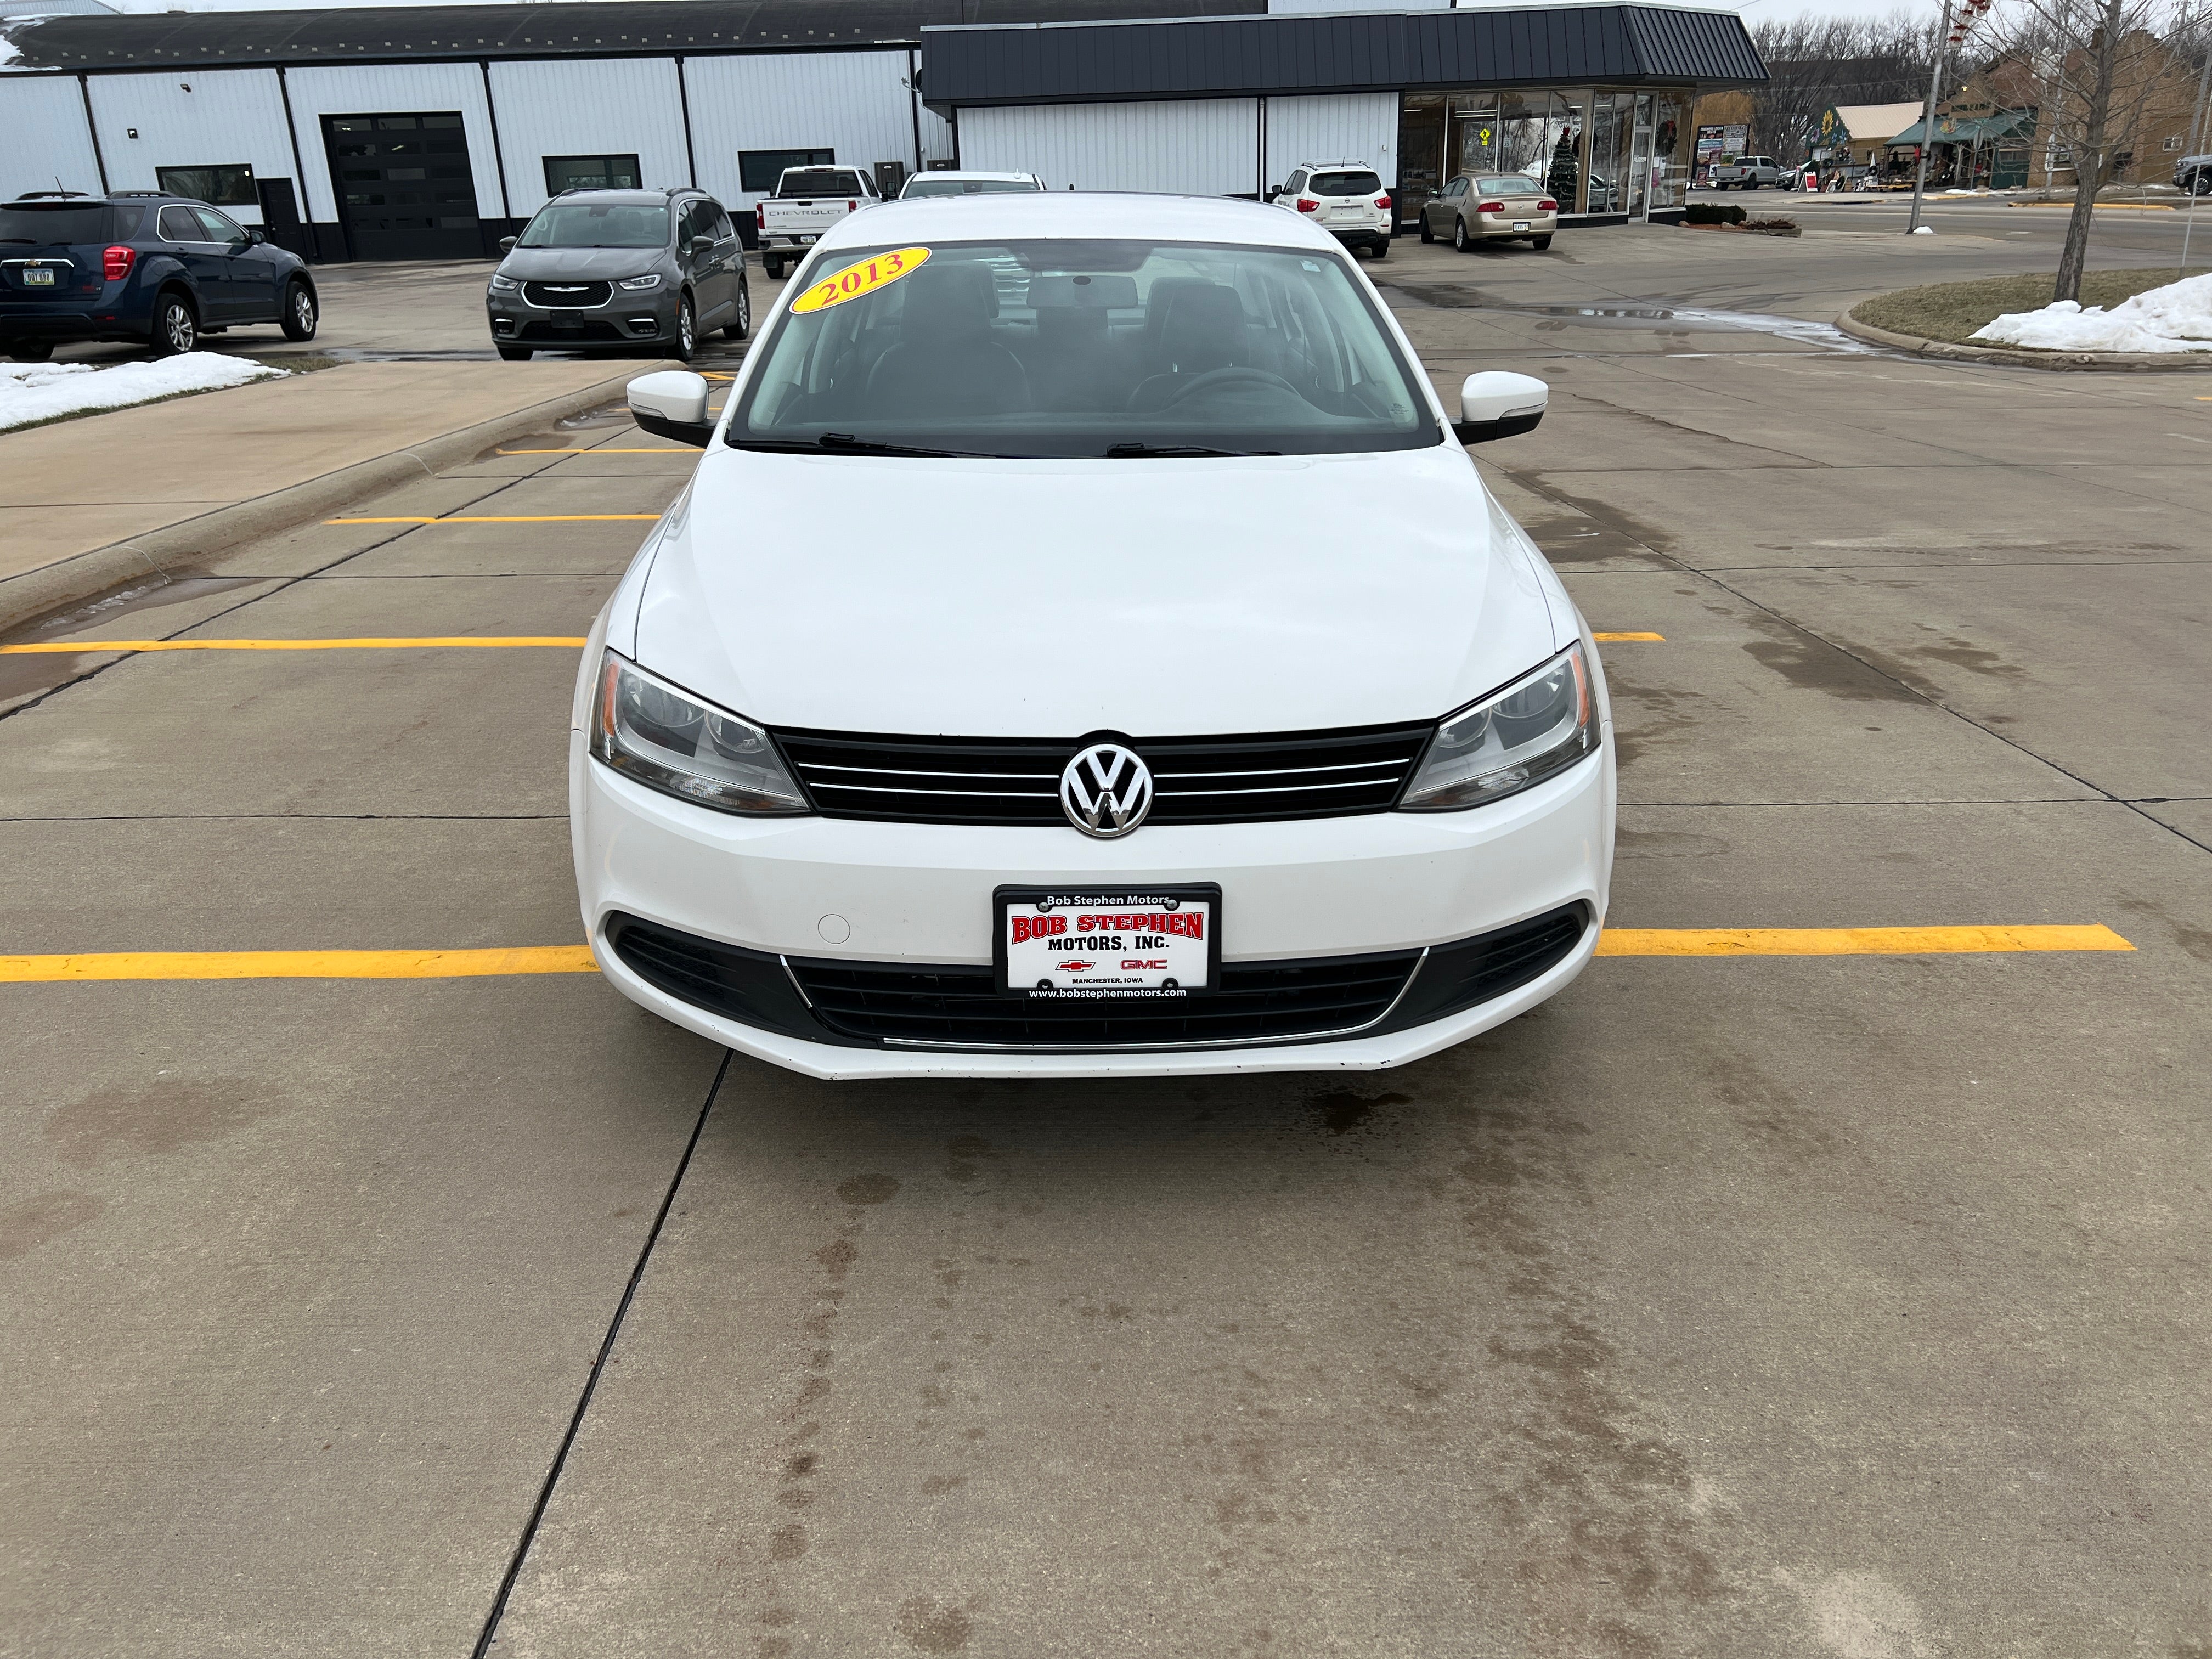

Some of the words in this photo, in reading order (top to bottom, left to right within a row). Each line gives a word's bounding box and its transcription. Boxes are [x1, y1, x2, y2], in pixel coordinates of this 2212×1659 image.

[819, 254, 903, 305] 2013
[1047, 896, 1071, 905] Bob
[1074, 896, 1124, 907] Stephen
[1127, 895, 1169, 905] Motors
[1012, 915, 1068, 945] BOB
[1076, 912, 1204, 940] STEPHEN
[1048, 936, 1127, 952] MOTORS,
[1135, 936, 1170, 949] INC.
[1120, 959, 1168, 970] GMC
[1029, 989, 1187, 999] www.bobstephenmotors.com
